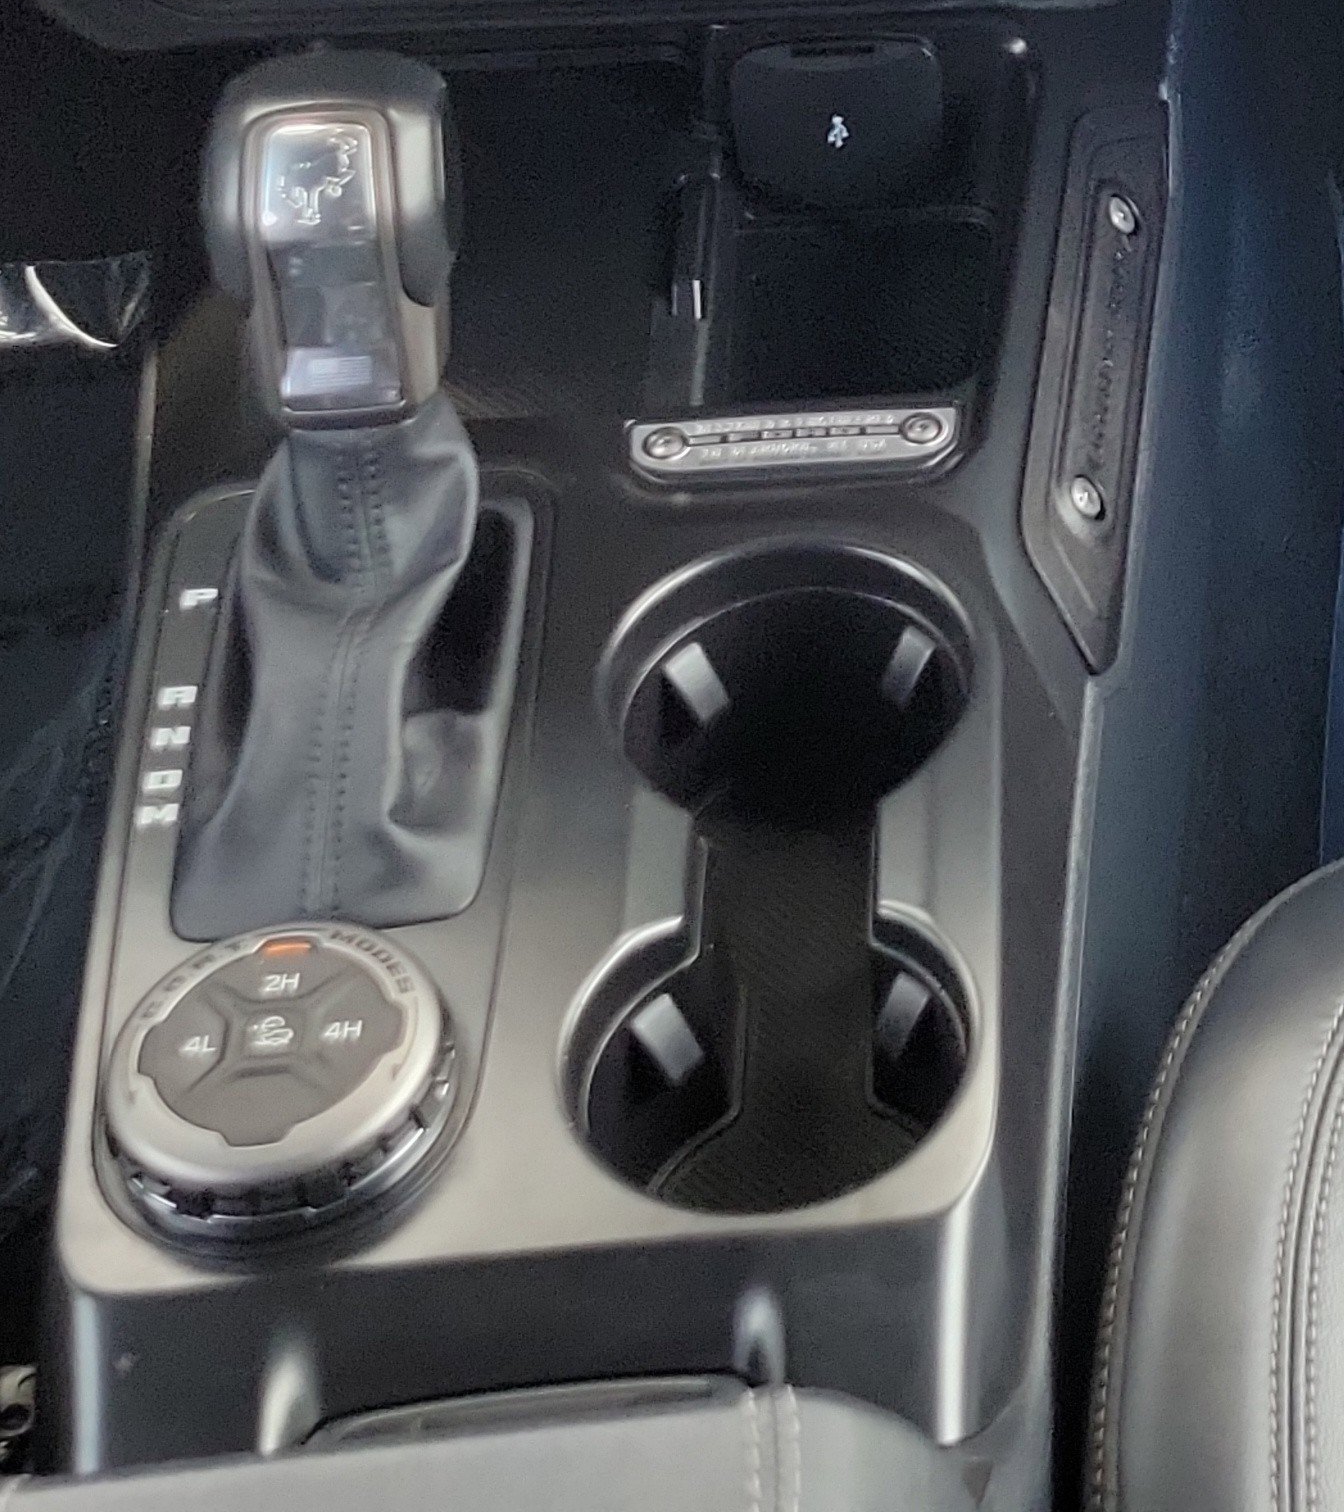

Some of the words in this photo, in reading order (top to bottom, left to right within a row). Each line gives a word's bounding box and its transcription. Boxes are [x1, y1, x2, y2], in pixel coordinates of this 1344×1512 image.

[180, 588, 218, 610] P
[157, 686, 198, 710] R
[150, 726, 191, 750] N
[142, 769, 183, 794] D
[136, 803, 179, 828] M
[331, 928, 417, 996] MODES
[262, 973, 300, 994] 2H
[323, 1019, 363, 1039] 4H
[180, 1035, 217, 1053] 4L
